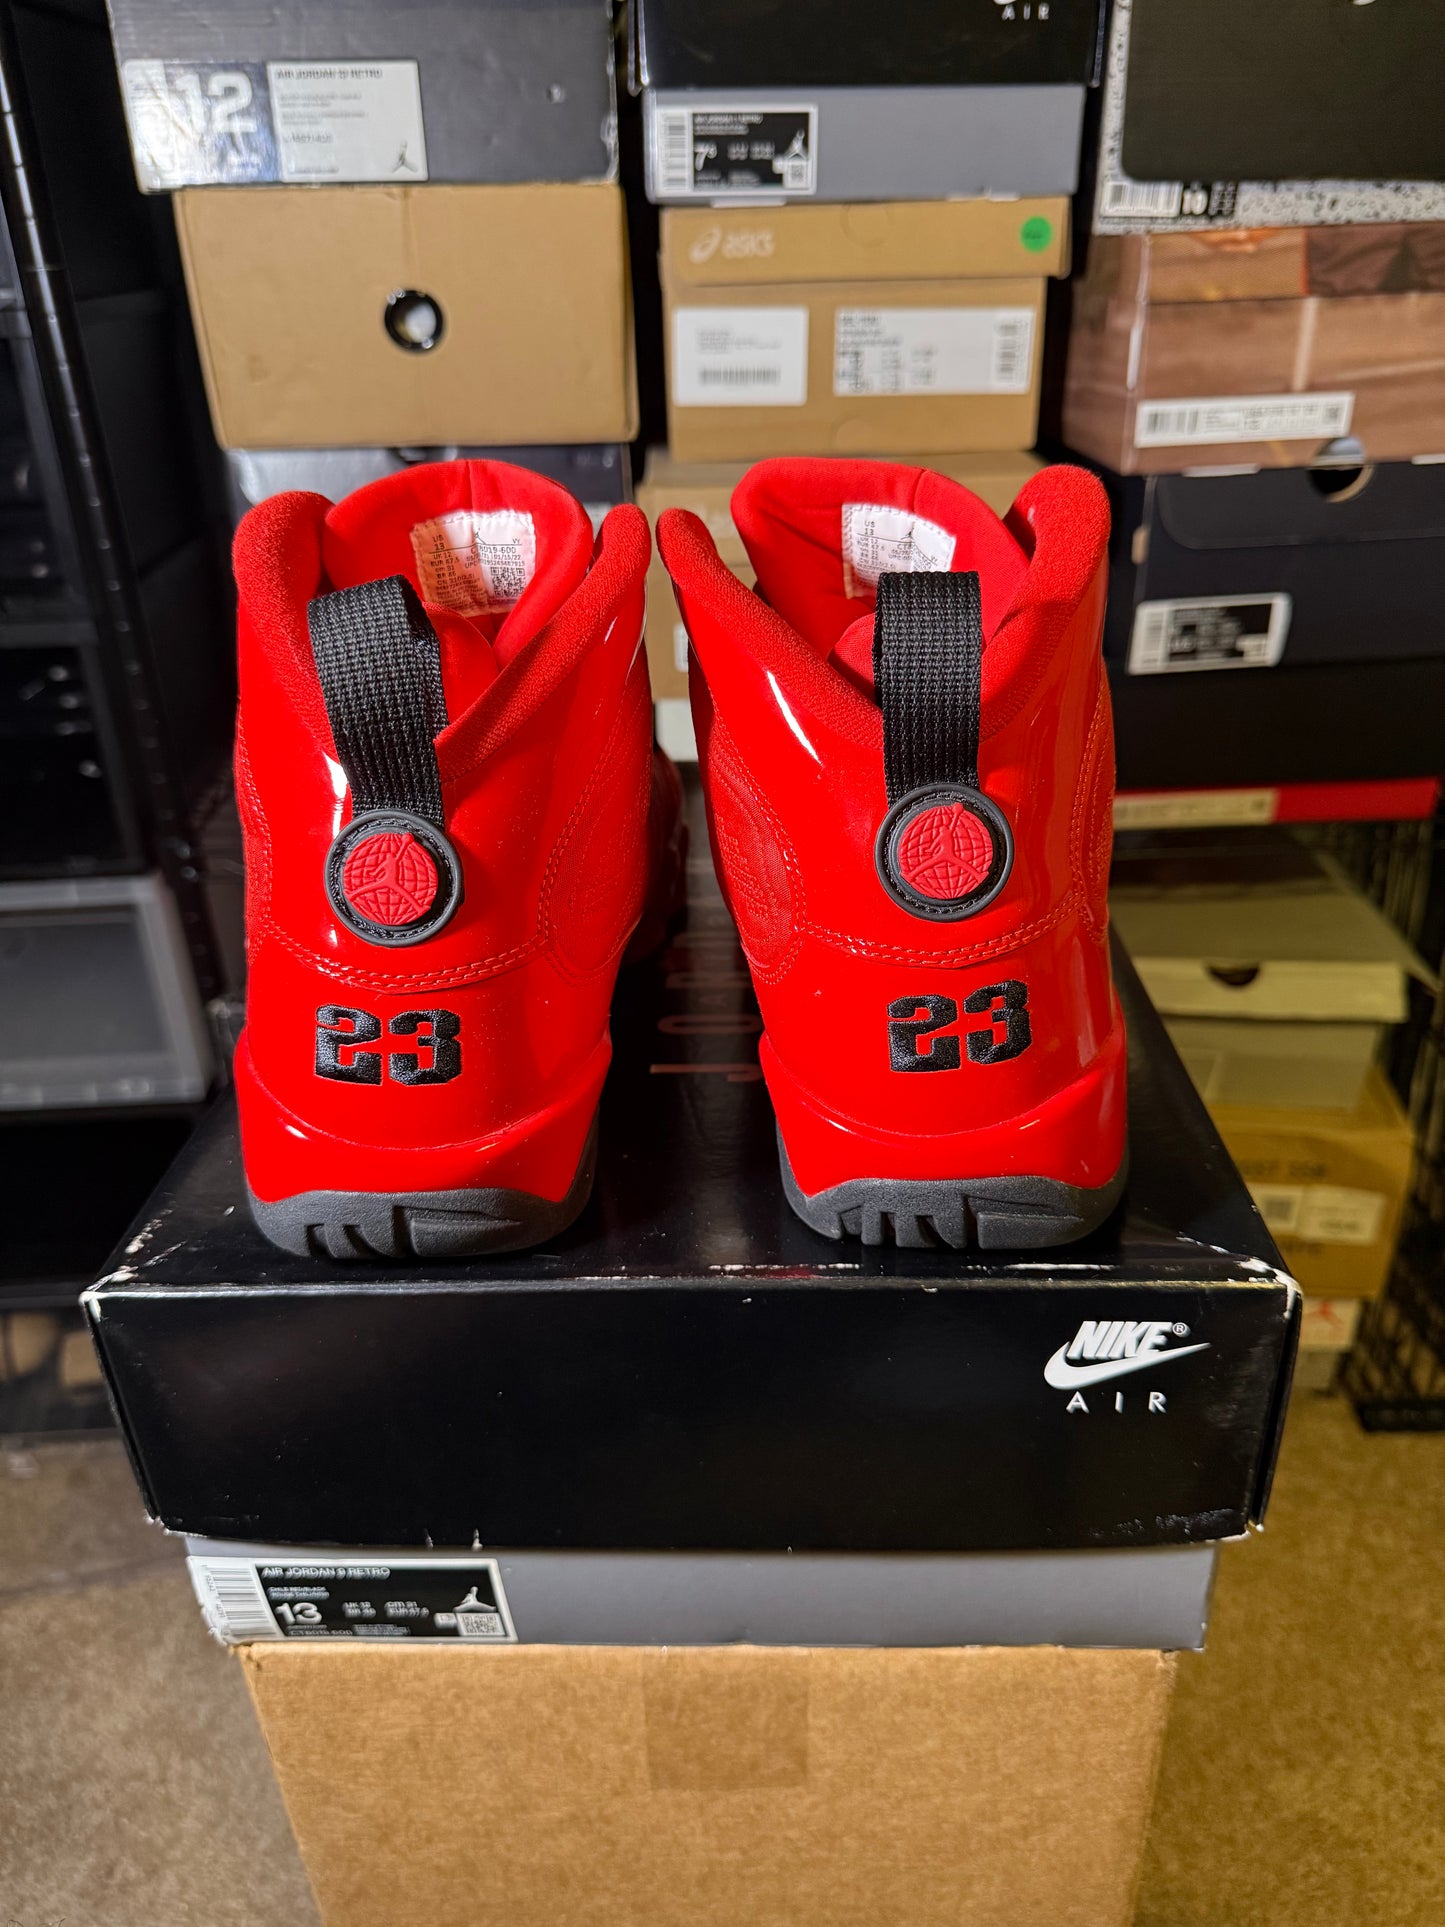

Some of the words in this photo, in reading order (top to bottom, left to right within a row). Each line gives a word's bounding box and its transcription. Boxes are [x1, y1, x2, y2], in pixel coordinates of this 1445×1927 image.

[1001, 3, 1050, 20] AIR
[175, 72, 258, 134] 12
[887, 979, 1033, 1074] 23
[314, 1003, 463, 1087] 23
[1065, 1391, 1168, 1414] AIR
[262, 1567, 283, 1579] AIR
[285, 1567, 336, 1579] JORDAN
[336, 1567, 345, 1579] 9
[346, 1567, 391, 1579] RETRO
[275, 1602, 322, 1625] 13
